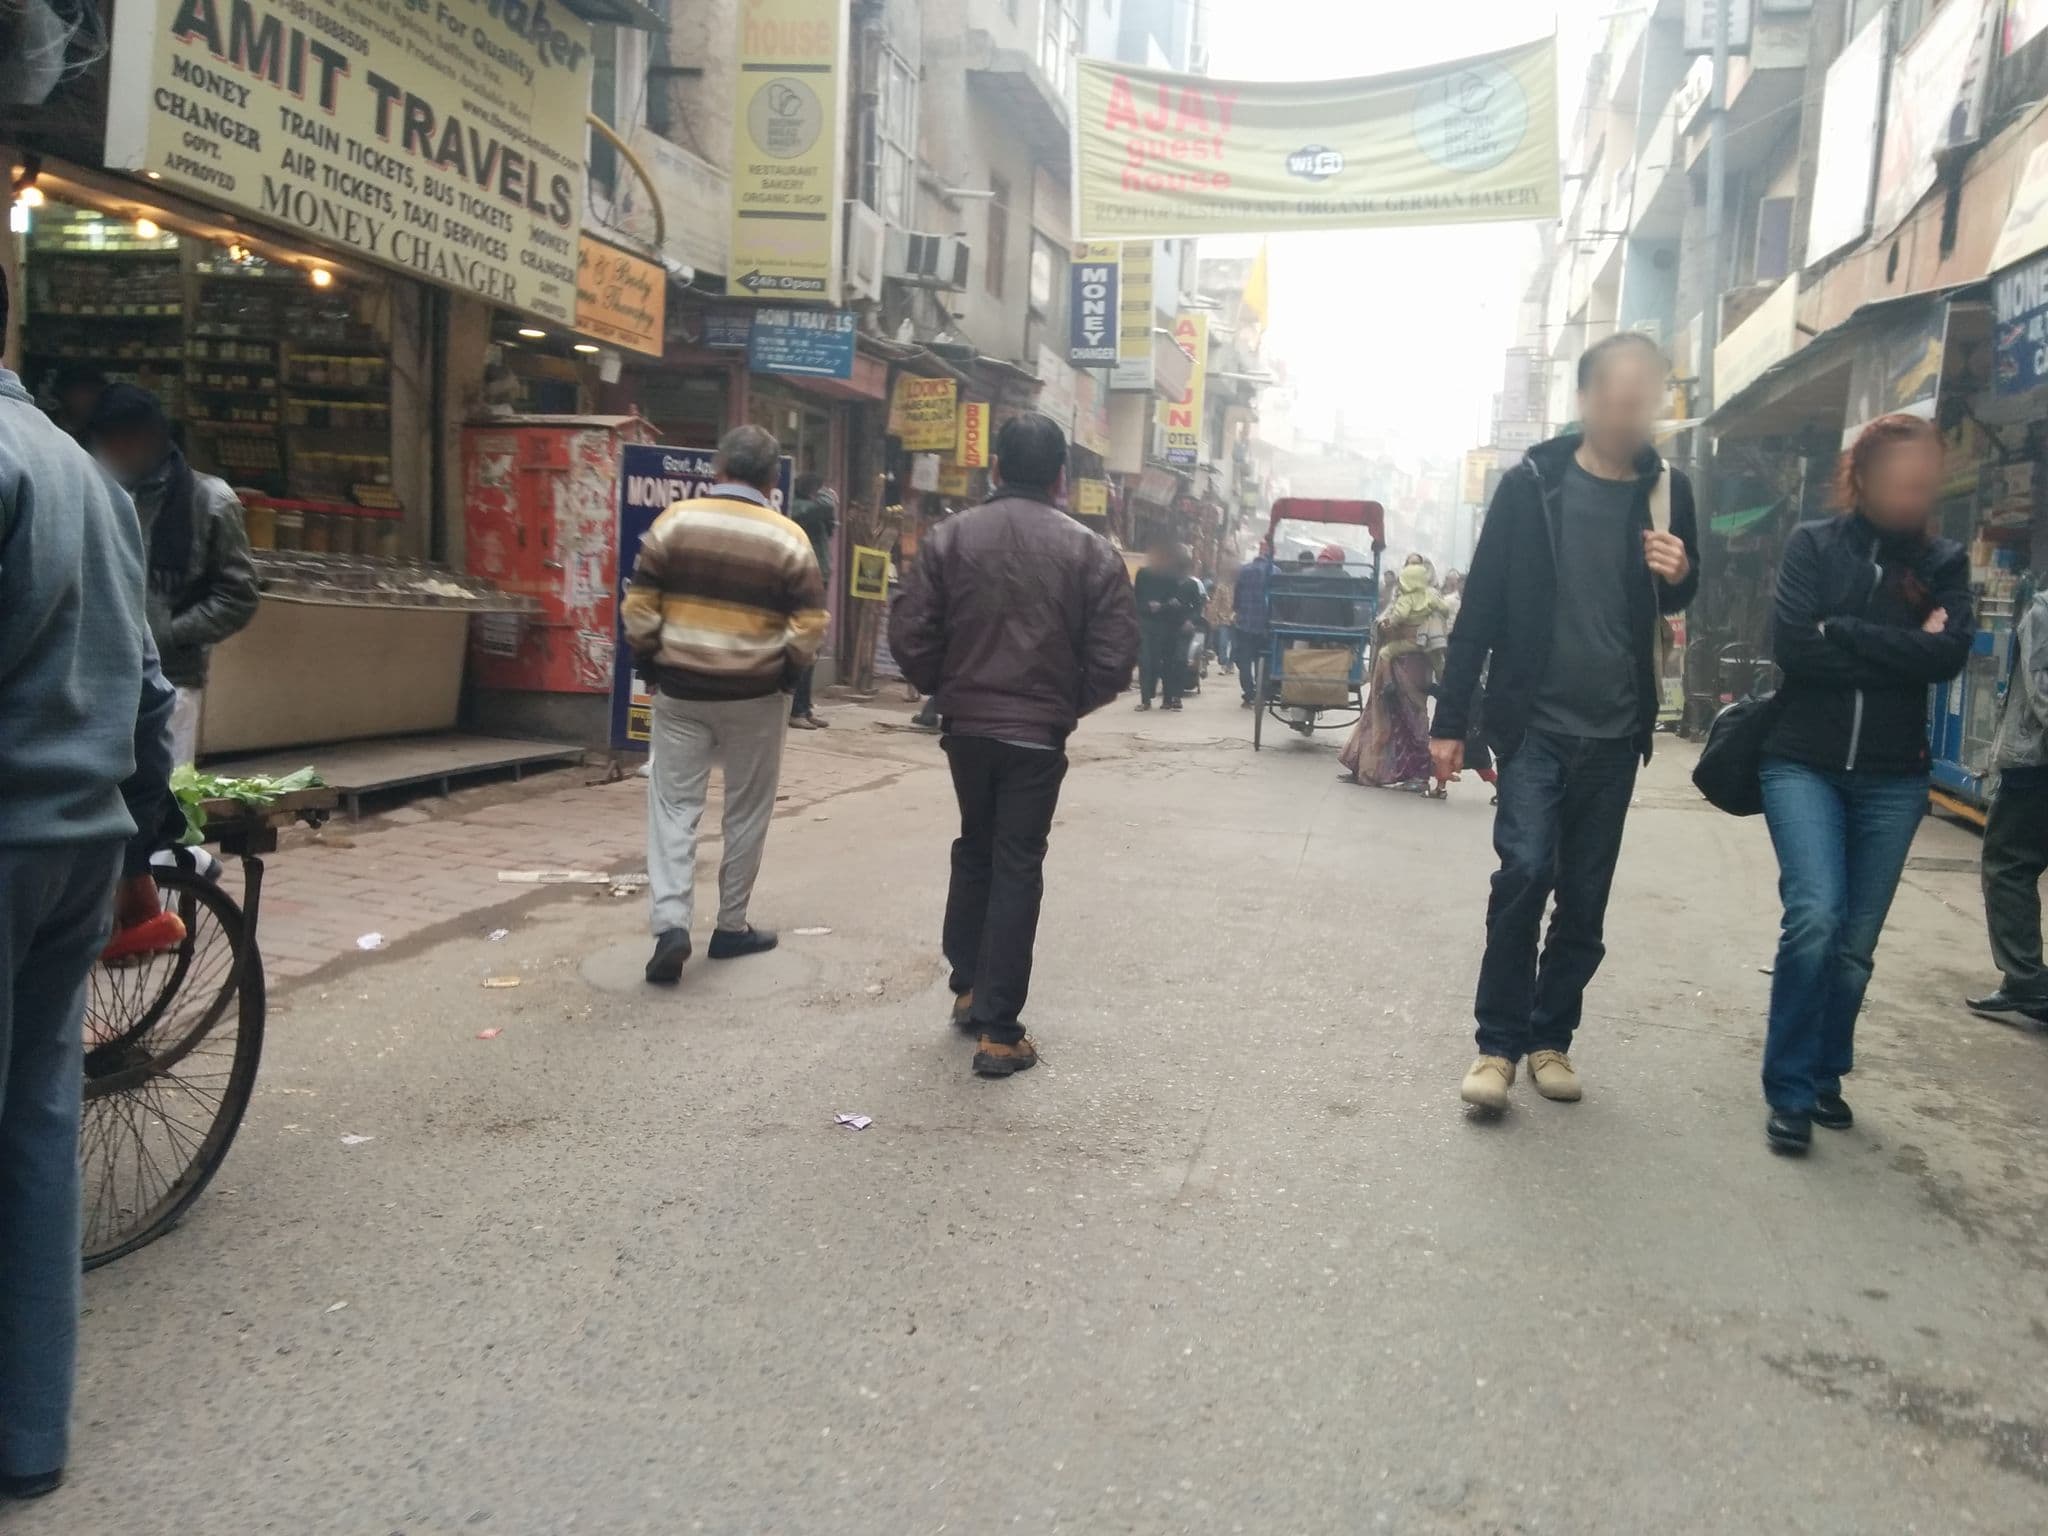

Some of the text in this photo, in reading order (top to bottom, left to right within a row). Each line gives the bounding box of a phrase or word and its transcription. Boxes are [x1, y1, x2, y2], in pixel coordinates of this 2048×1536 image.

[743, 17, 833, 56] house
[472, 27, 535, 87] Quality
[172, 53, 250, 109] MONEY
[154, 87, 261, 152] CHANGER
[171, 0, 572, 230] AMIT TRAVELS
[1104, 74, 1241, 132] AJAY
[280, 105, 513, 233] TRAIN TICKETS, BUS TICKETS
[1126, 133, 1225, 169] guest
[165, 152, 236, 191] APPROVED
[748, 164, 819, 176] RESTAURANT
[760, 178, 804, 190] BAKERY
[1121, 167, 1233, 193] house
[281, 147, 508, 261] AIR TICKETS, TAXI SERVICES
[1296, 200, 1375, 215] ORGANIC
[1385, 192, 1465, 212] GERMAN
[1469, 187, 1540, 208] BAKERY
[259, 173, 518, 304] MONEY CHANGER
[529, 223, 570, 256] MONEY
[520, 249, 575, 286] CHANGER
[780, 276, 822, 290] Open
[792, 310, 853, 333] TRAVELS
[1081, 267, 1108, 346] MONEY
[1071, 347, 1115, 360] CHANGER
[1168, 432, 1198, 446] OTEL
[662, 455, 692, 474] Govt.
[627, 475, 693, 507] MONEY
